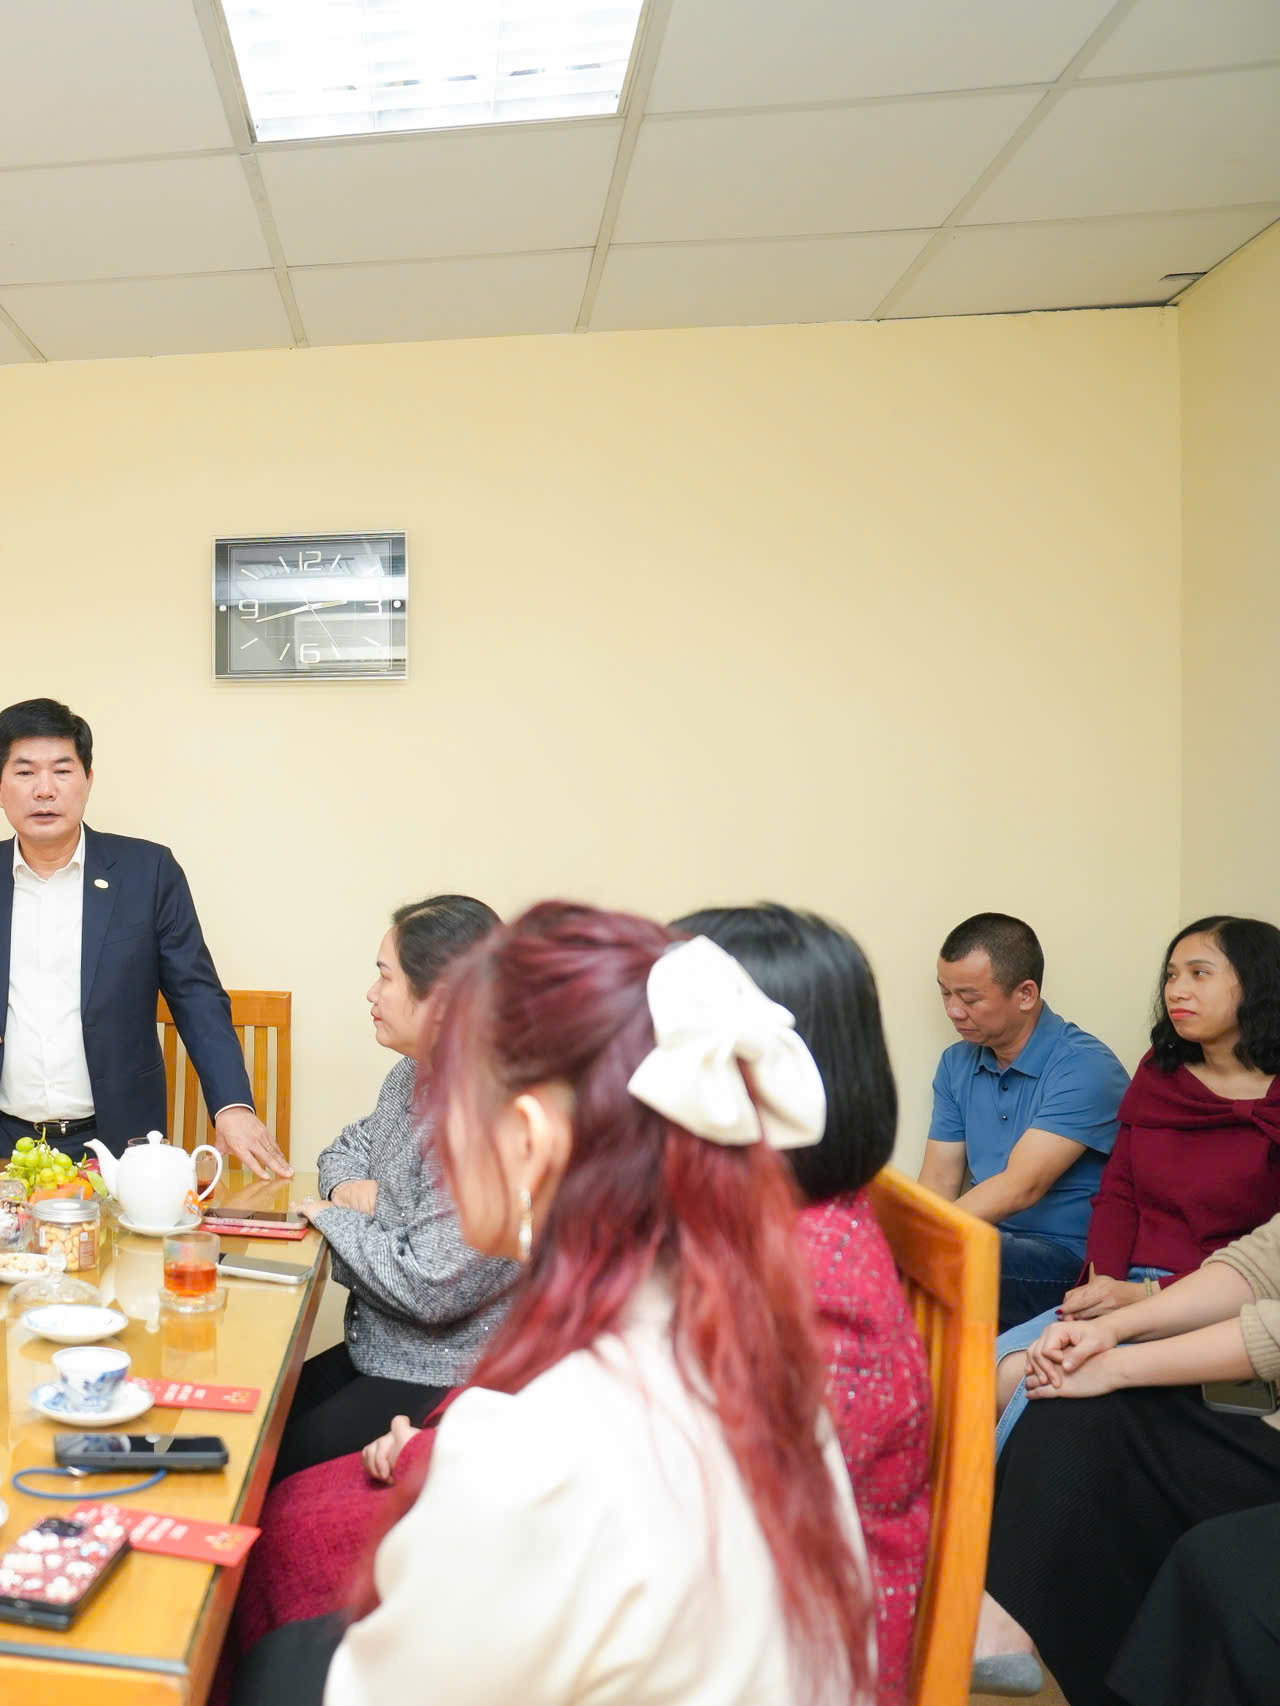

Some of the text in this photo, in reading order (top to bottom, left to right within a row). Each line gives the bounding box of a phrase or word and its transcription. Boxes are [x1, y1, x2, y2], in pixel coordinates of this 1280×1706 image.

[298, 550, 322, 572] 12
[238, 599, 259, 619] 9
[364, 598, 383, 617] 3
[299, 643, 321, 664] 6
